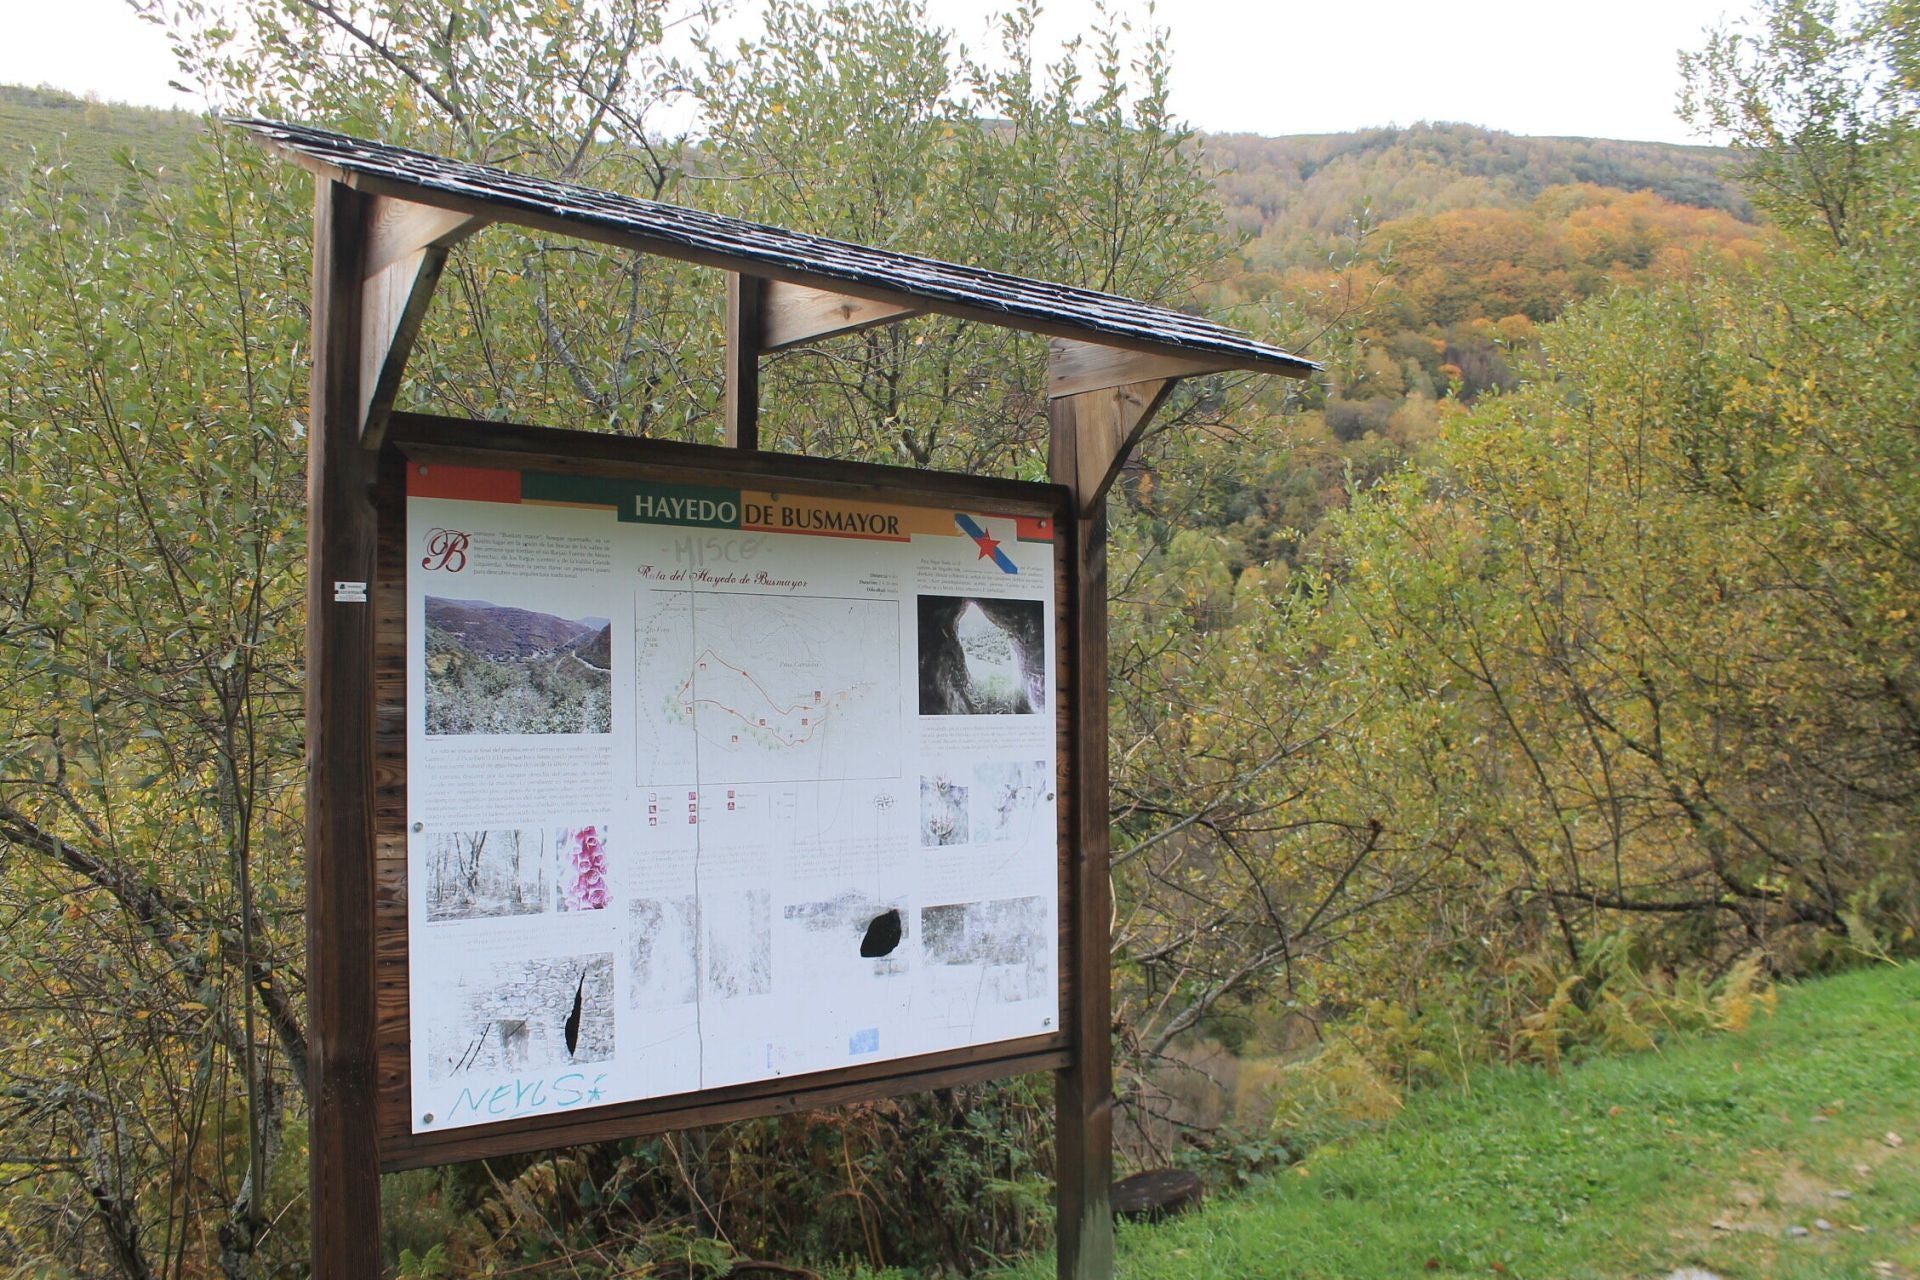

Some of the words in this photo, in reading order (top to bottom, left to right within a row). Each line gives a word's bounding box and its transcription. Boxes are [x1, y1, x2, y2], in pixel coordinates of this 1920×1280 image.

[635, 495, 737, 523] HAYEDO
[745, 504, 774, 526] DE
[782, 506, 899, 535] BUSMAYOR
[669, 569, 687, 581] del
[689, 568, 736, 587] Hayedo
[739, 573, 750, 585] de
[754, 570, 808, 592] Busmayor
